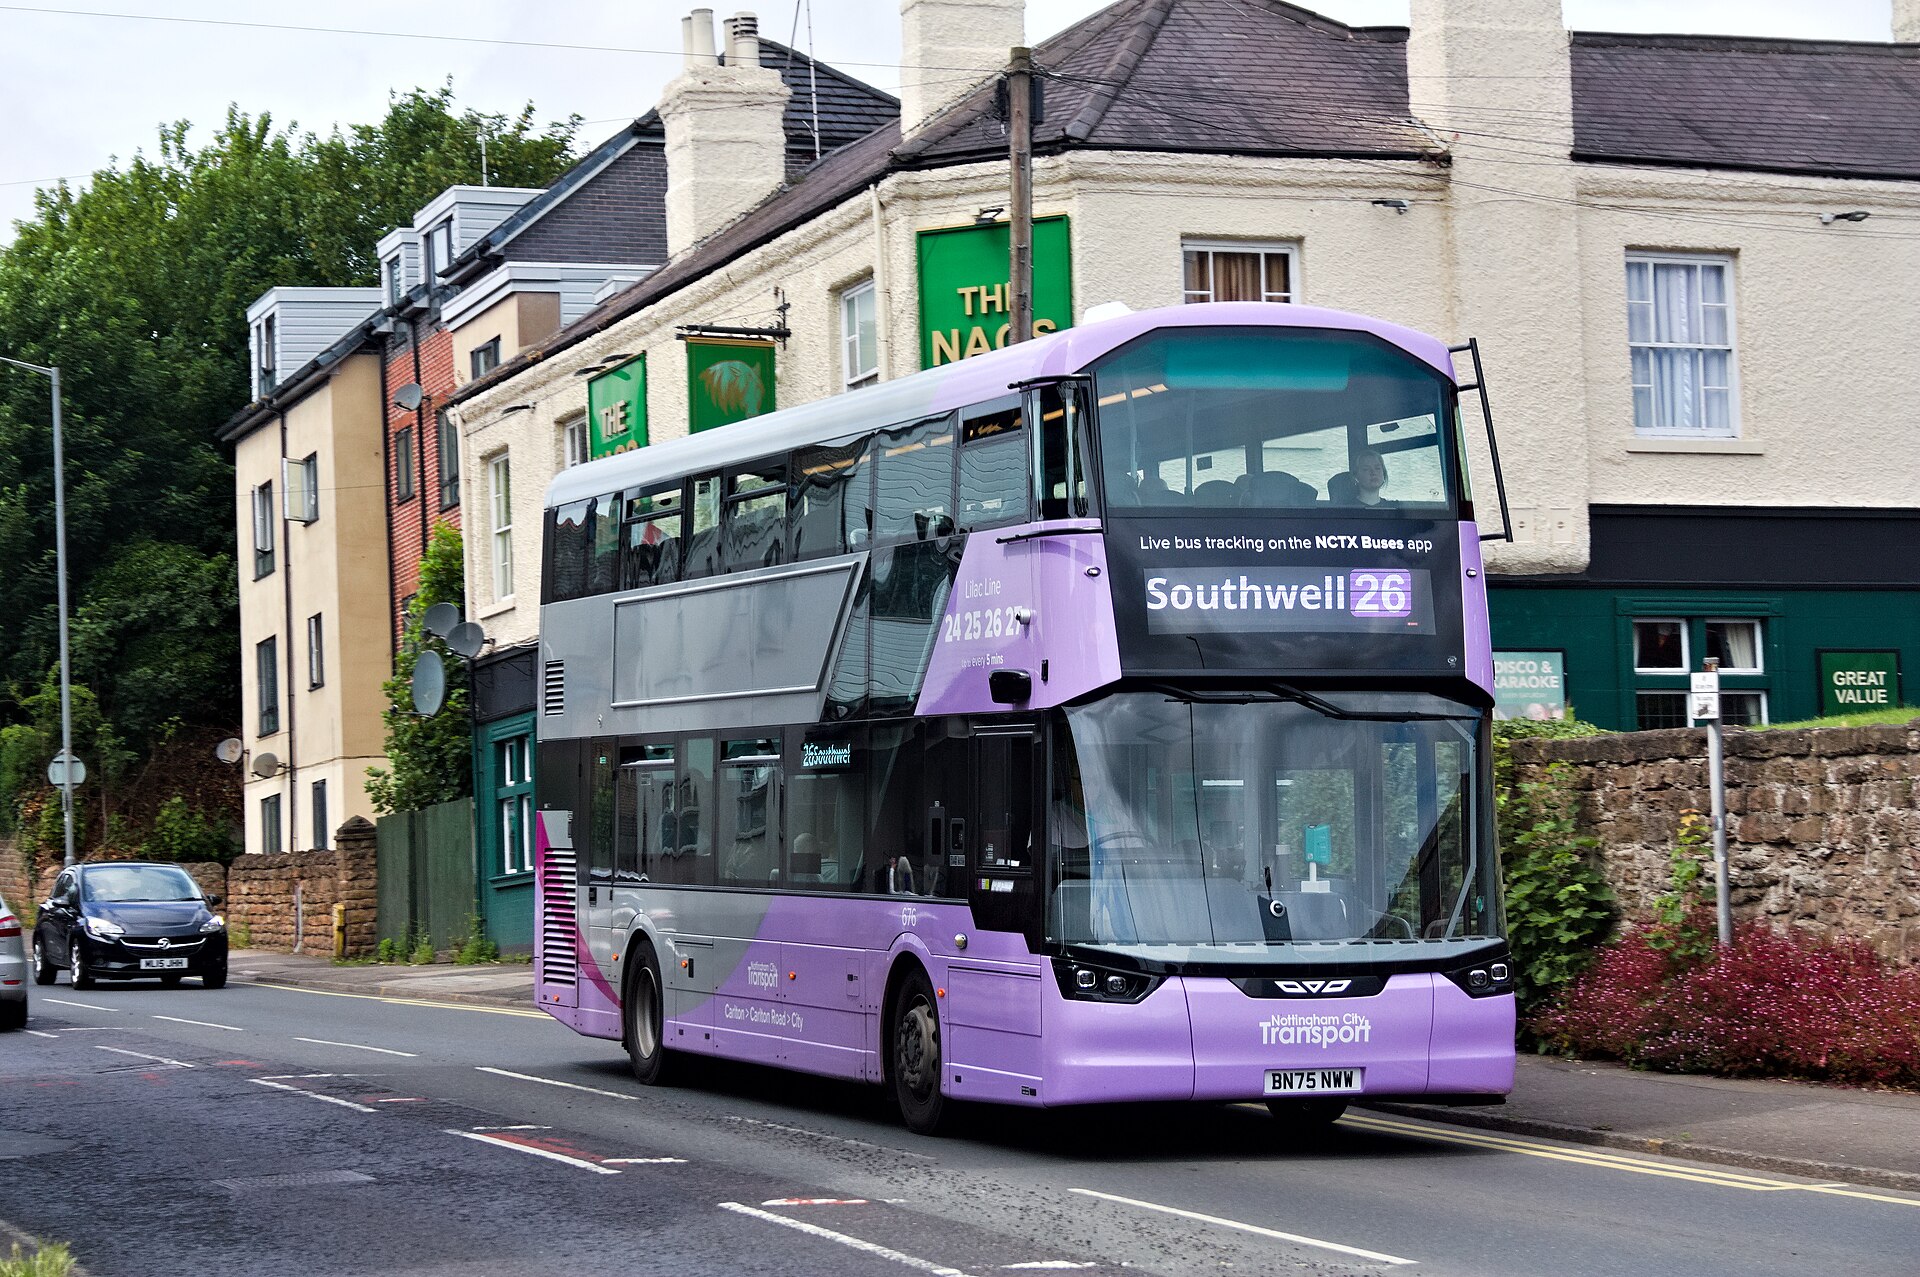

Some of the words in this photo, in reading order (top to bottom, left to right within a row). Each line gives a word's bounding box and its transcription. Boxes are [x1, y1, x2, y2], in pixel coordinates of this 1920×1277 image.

[600, 400, 627, 438] THE
[1140, 536, 1171, 550] Live
[1174, 535, 1202, 549] bus
[1205, 535, 1264, 552] tracking
[1268, 538, 1287, 549] on
[1288, 536, 1312, 549] the
[1315, 535, 1359, 549] NCTX
[1361, 535, 1404, 550] Buses
[1407, 539, 1433, 553] app
[965, 580, 983, 599] Lilac
[984, 578, 1001, 596] Line
[1146, 575, 1345, 610] Southwell
[1354, 574, 1406, 613] 26
[944, 613, 961, 643] 24
[964, 610, 982, 641] 25
[984, 607, 1002, 638] 26
[1005, 605, 1023, 636] 27
[972, 656, 986, 669] every
[986, 654, 990, 666] 5
[991, 652, 1004, 665] mins
[1494, 660, 1538, 674] DISCO
[1541, 660, 1553, 674] &
[1832, 671, 1887, 686] GREAT
[1834, 689, 1889, 704] VALUE
[901, 907, 917, 926] 676
[747, 966, 779, 991] Transport
[725, 1003, 745, 1020] Carlton
[749, 1006, 771, 1023] Carlton
[771, 1009, 787, 1026] Road
[791, 1012, 804, 1032] City
[1271, 1014, 1340, 1028] Nottingham
[1342, 1013, 1366, 1025] City
[1259, 1019, 1372, 1049] Transport
[1271, 1072, 1316, 1090] BN75
[1321, 1071, 1354, 1088] NWW
